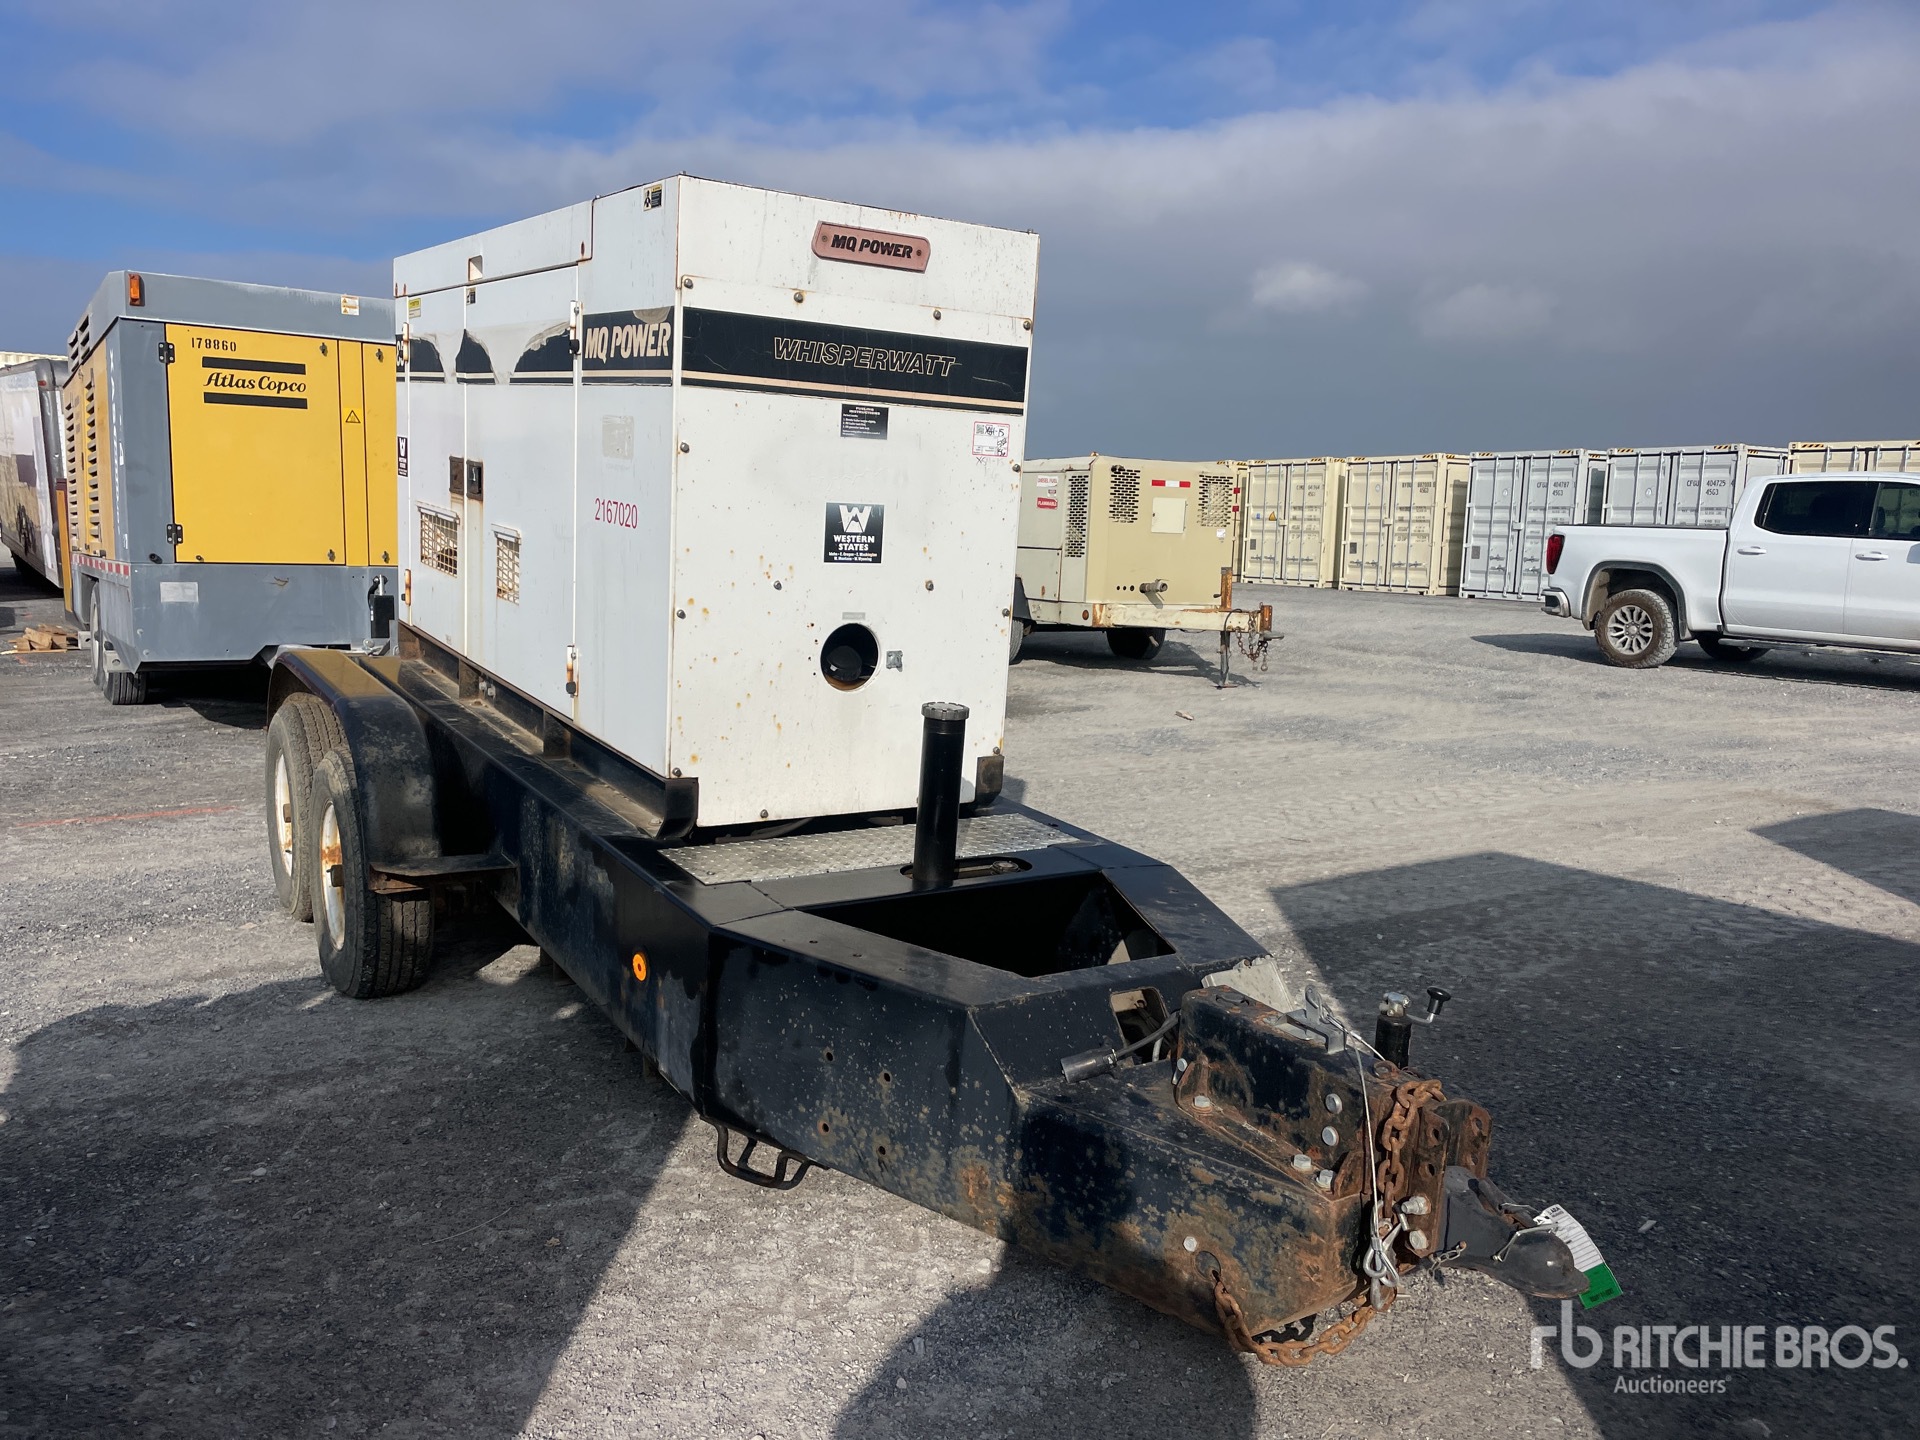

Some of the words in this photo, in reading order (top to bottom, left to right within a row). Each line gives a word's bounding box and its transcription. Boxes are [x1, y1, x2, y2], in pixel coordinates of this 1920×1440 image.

[830, 234, 857, 252] MQ
[859, 239, 913, 259] POWER
[191, 337, 237, 352] 178860
[585, 326, 609, 364] MQ
[610, 322, 671, 359] POWER
[774, 336, 956, 377] WHISPERWATT
[203, 372, 256, 389] Atlas
[258, 375, 307, 394] Copco
[1706, 479, 1726, 487] 404725
[595, 497, 638, 529] 2167020
[833, 534, 876, 544] WESTERN
[838, 542, 870, 552] STATES
